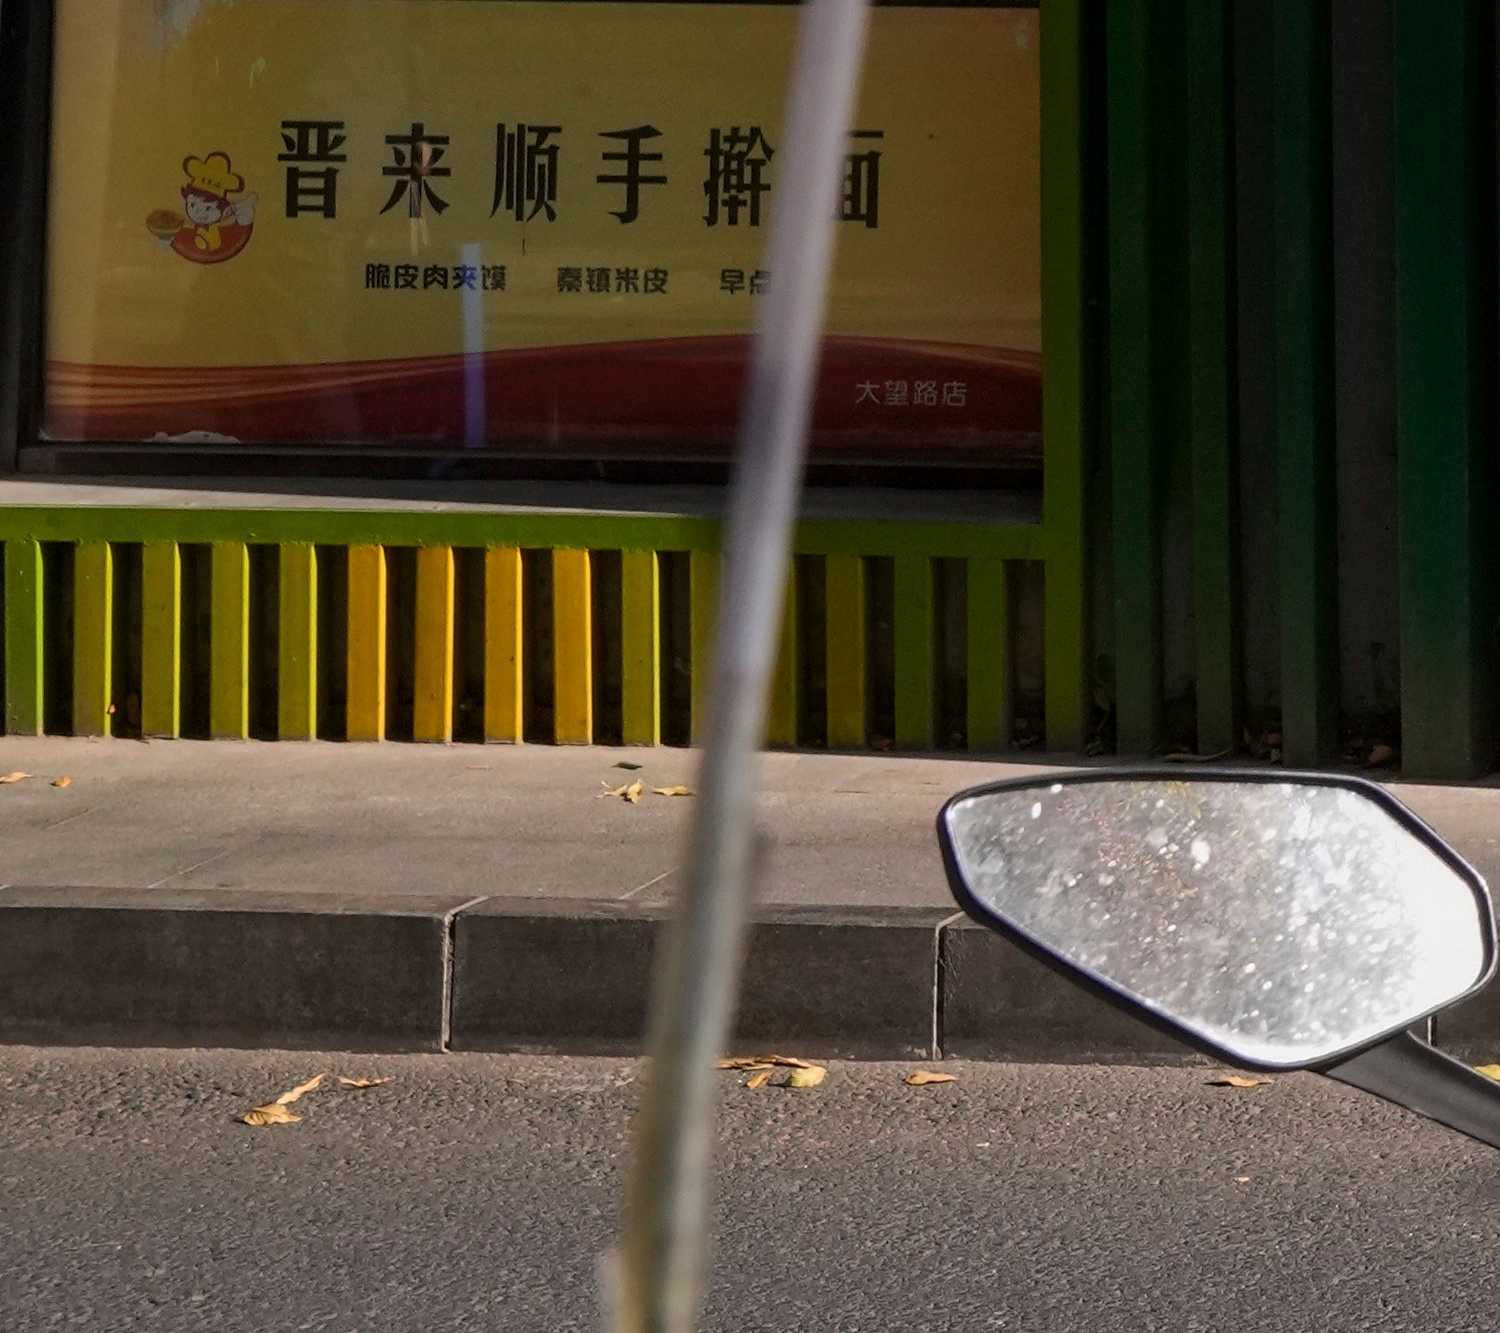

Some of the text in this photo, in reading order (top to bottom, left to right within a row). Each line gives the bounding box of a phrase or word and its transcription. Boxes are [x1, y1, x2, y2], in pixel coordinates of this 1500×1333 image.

[365, 263, 507, 291] 脆皮肉夹馍
[557, 266, 669, 294] 秦镇米皮
[855, 379, 967, 407] 大望路店
